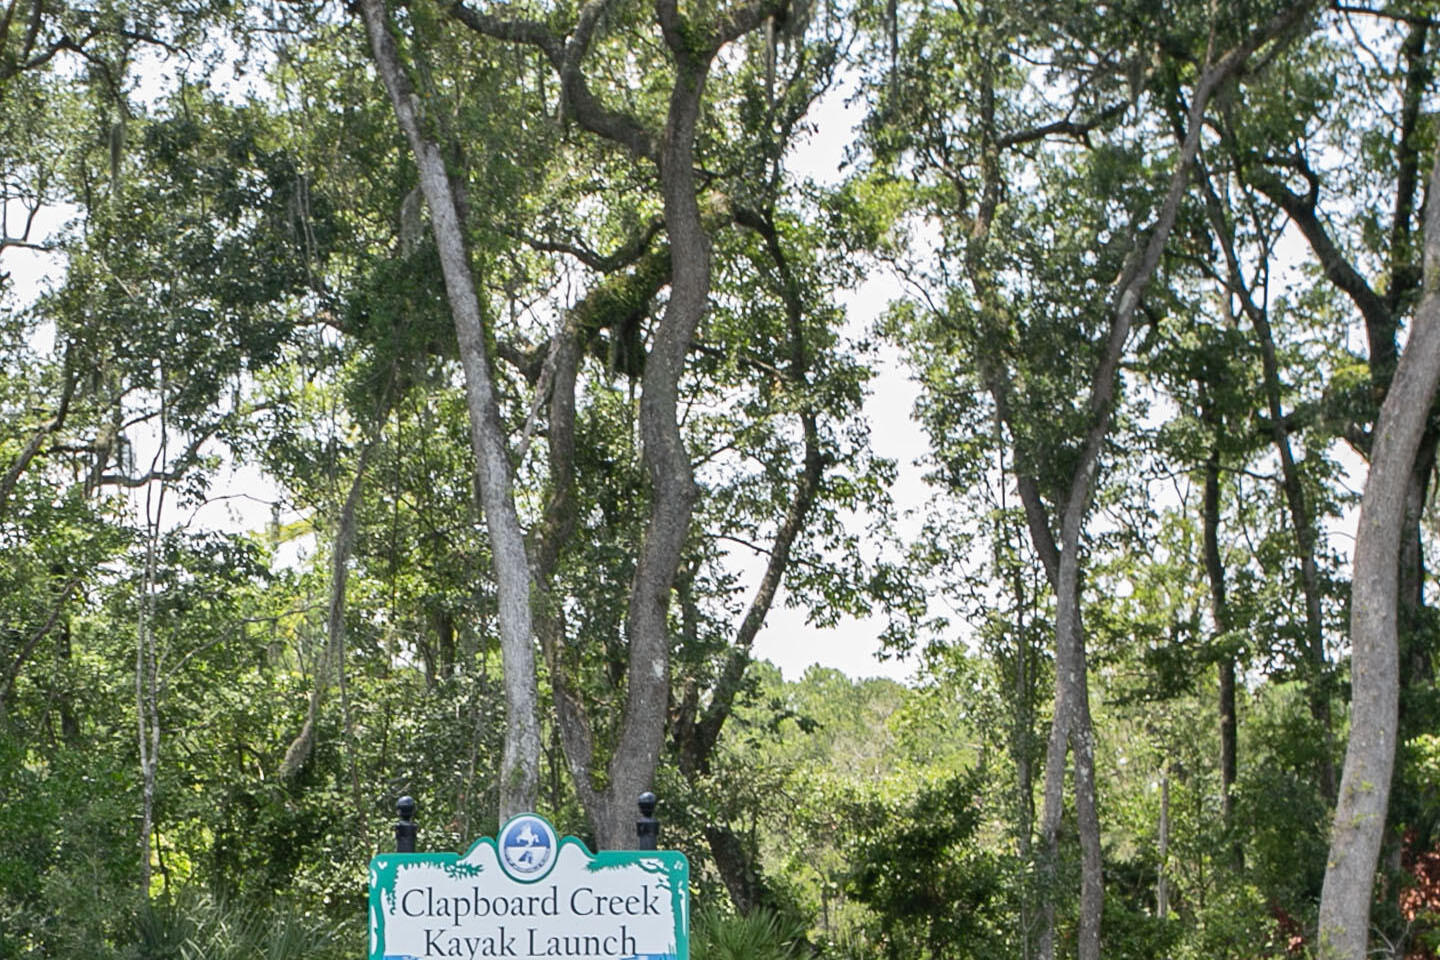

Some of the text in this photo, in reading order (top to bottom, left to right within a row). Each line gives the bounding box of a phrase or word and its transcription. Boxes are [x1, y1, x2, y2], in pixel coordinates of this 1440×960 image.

[401, 885, 660, 926] Clapboard Creek
[527, 925, 637, 957] Launch
